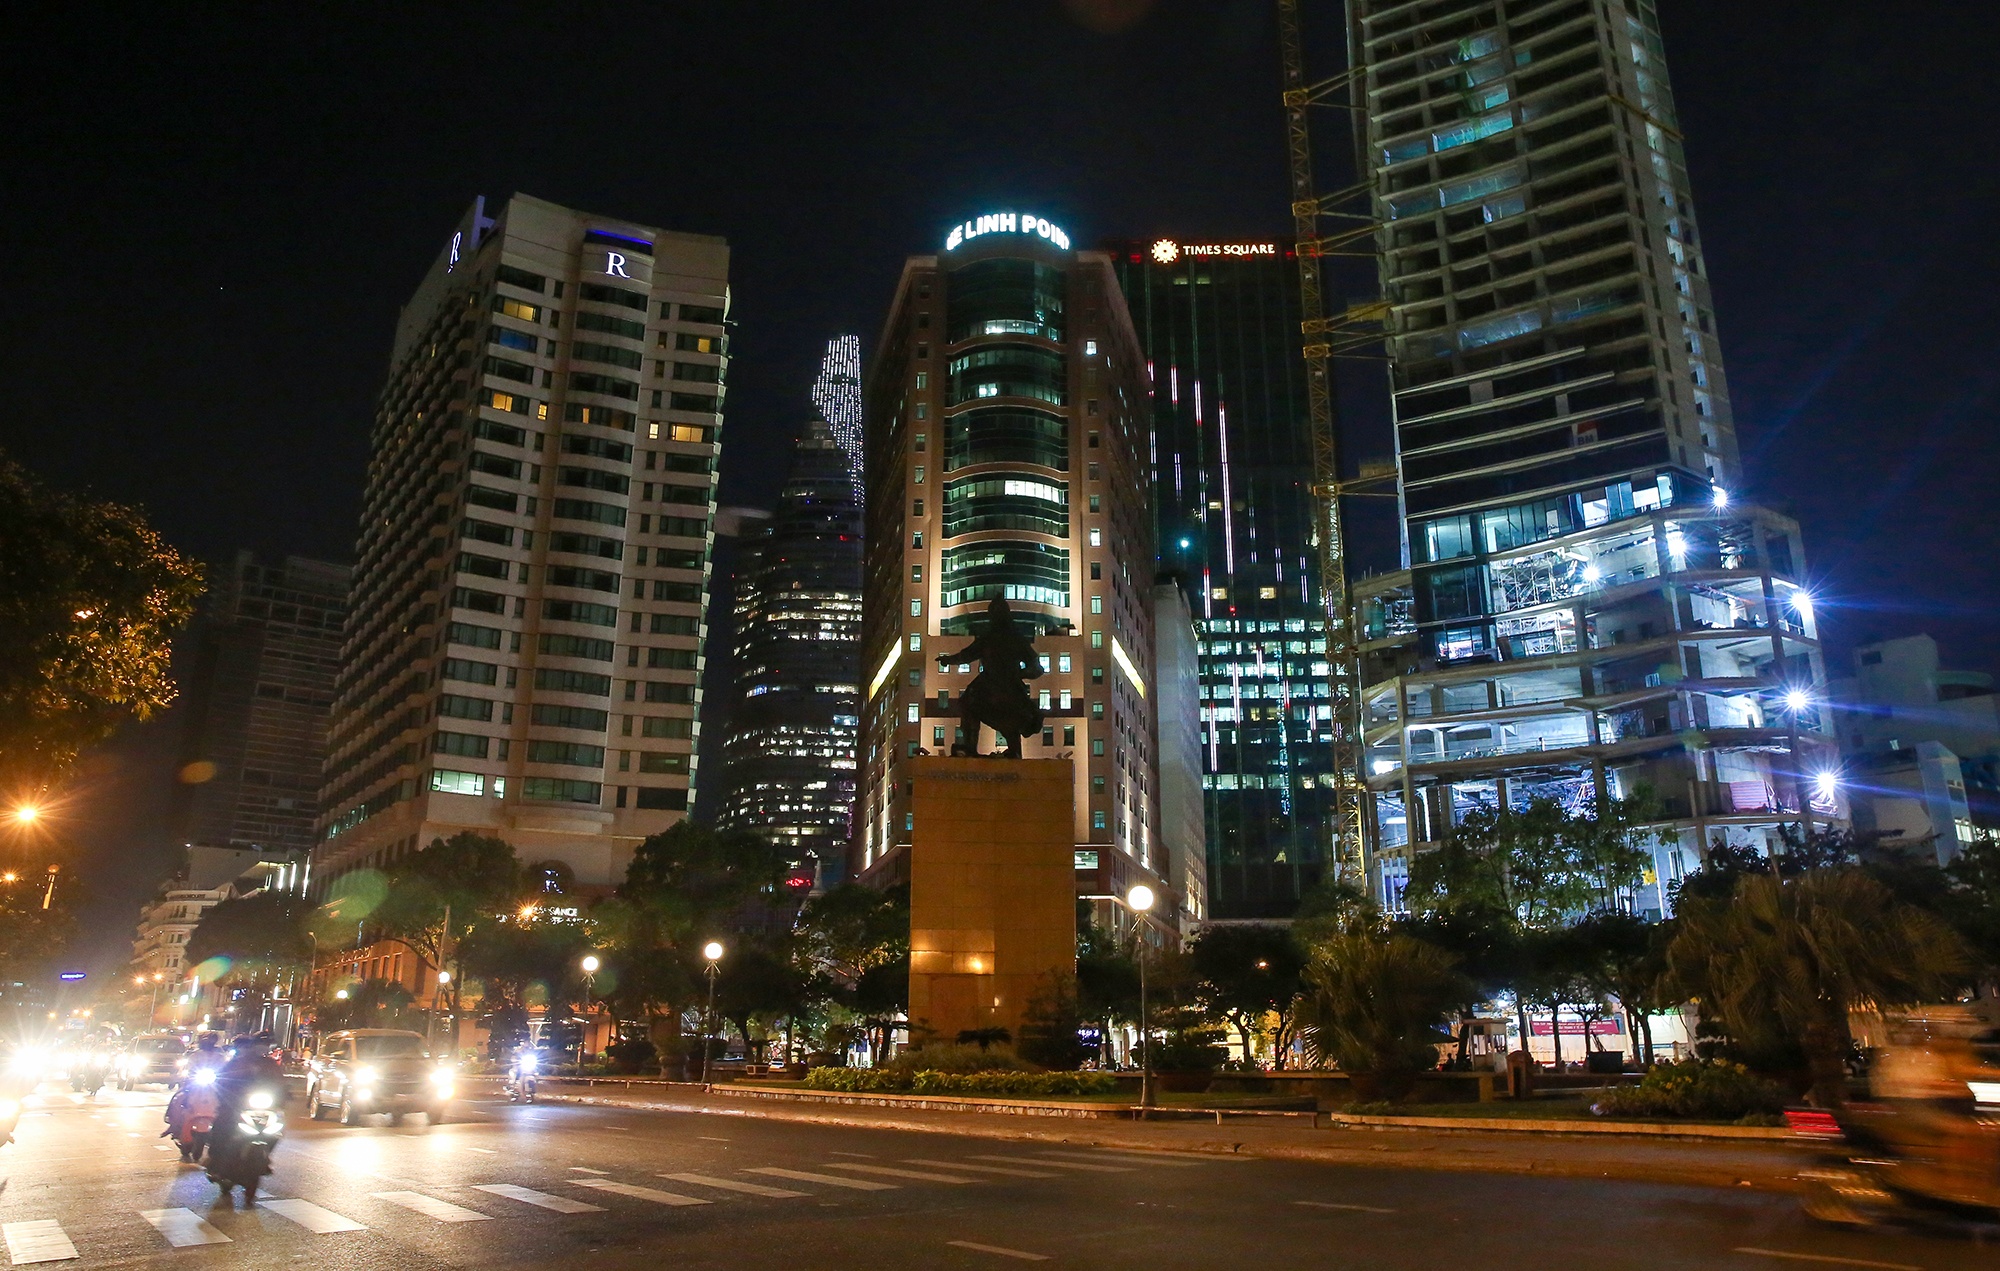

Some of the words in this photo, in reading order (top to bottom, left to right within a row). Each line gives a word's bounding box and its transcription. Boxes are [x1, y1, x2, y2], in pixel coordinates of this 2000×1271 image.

[965, 213, 1016, 239] LINH
[1182, 244, 1221, 256] TIMES
[1222, 243, 1276, 256] SQUARE
[605, 252, 631, 279] R
